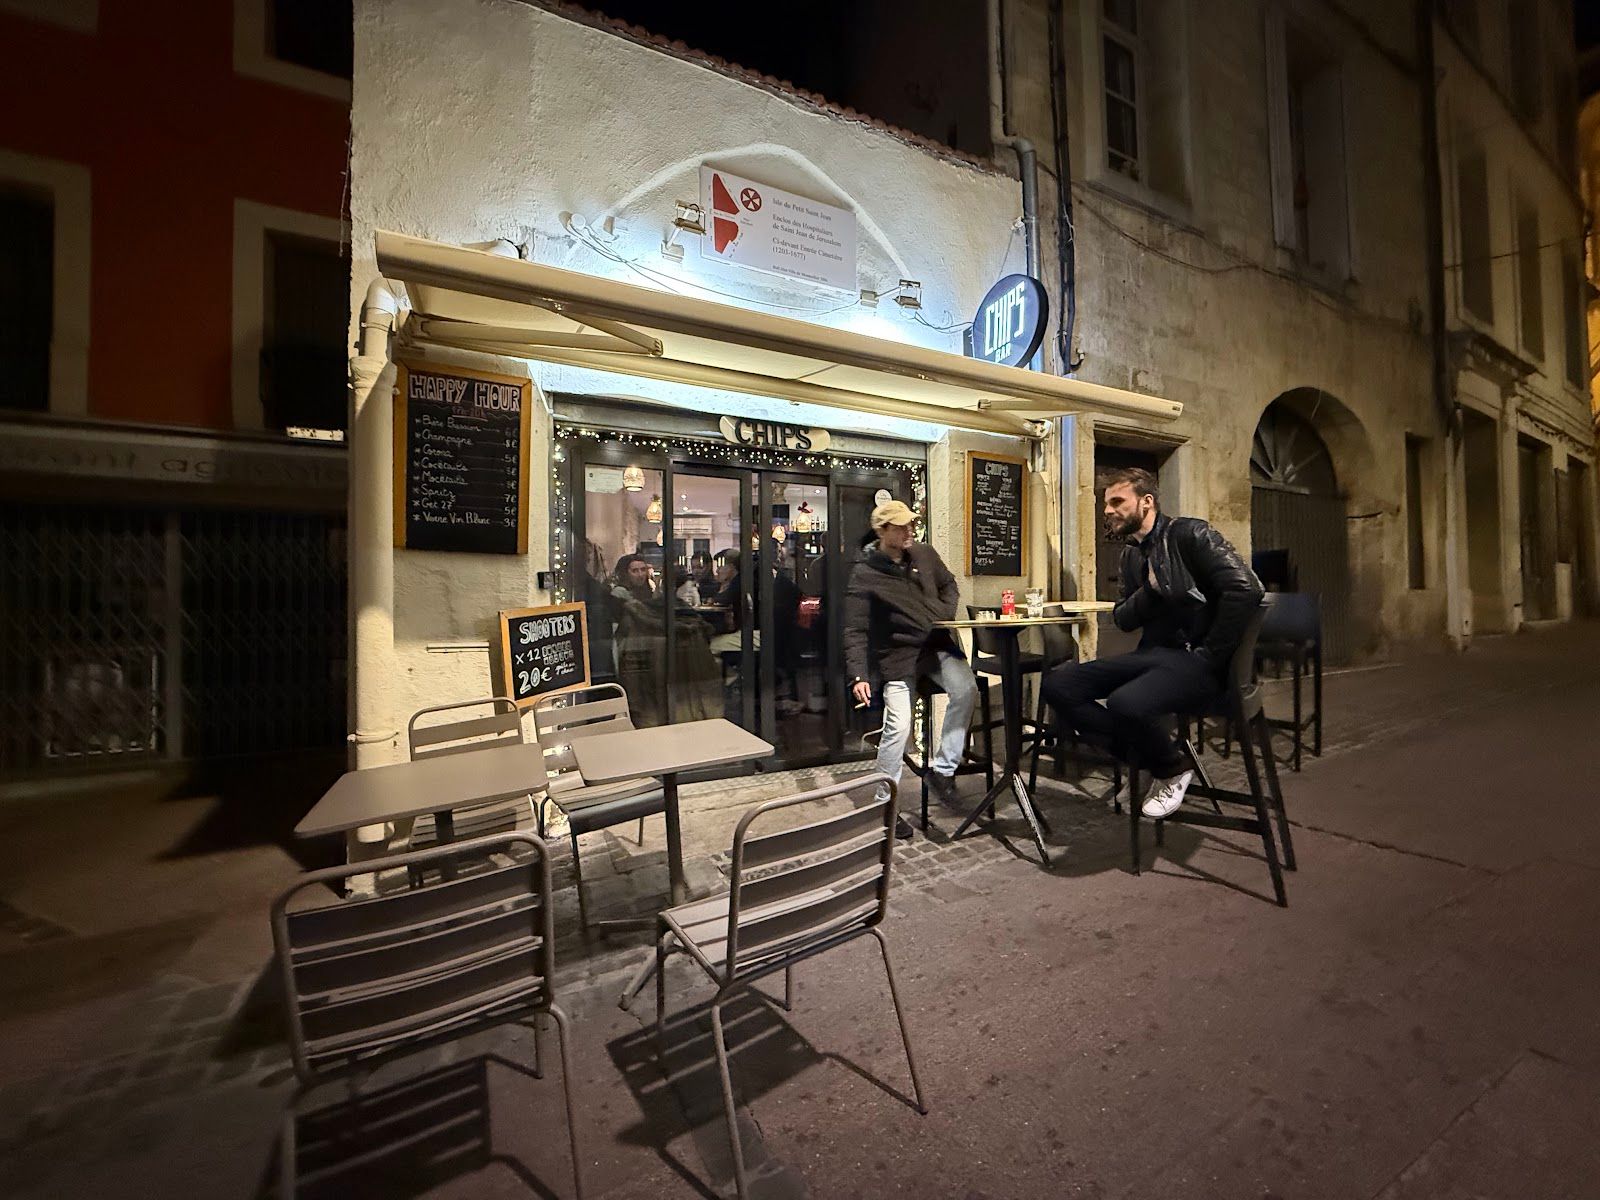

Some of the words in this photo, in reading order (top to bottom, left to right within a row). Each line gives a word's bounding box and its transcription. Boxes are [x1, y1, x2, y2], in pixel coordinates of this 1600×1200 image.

[792, 219, 801, 228] des
[806, 208, 819, 218] Saint
[820, 212, 832, 221] Jean
[780, 225, 795, 234] Saint
[796, 229, 808, 238] Jean
[984, 281, 1025, 357] CHIPS
[995, 342, 1011, 363] BAR
[409, 374, 468, 404] HAPPY
[474, 382, 520, 412] HOUR
[422, 428, 474, 448] Champagne
[734, 420, 812, 450] CHIPS
[422, 443, 455, 458] Corona
[504, 453, 518, 464] 5€
[420, 483, 456, 502] Spritz
[504, 493, 517, 504] 7€
[441, 501, 453, 510] 27
[504, 506, 517, 516] 5€
[422, 511, 448, 524] Verre
[448, 512, 464, 525] Vin
[465, 511, 491, 525] Blanc
[503, 518, 516, 528] 3€
[519, 614, 576, 644] SHOOTERS
[527, 648, 541, 662] 12
[518, 667, 552, 695] 20€
